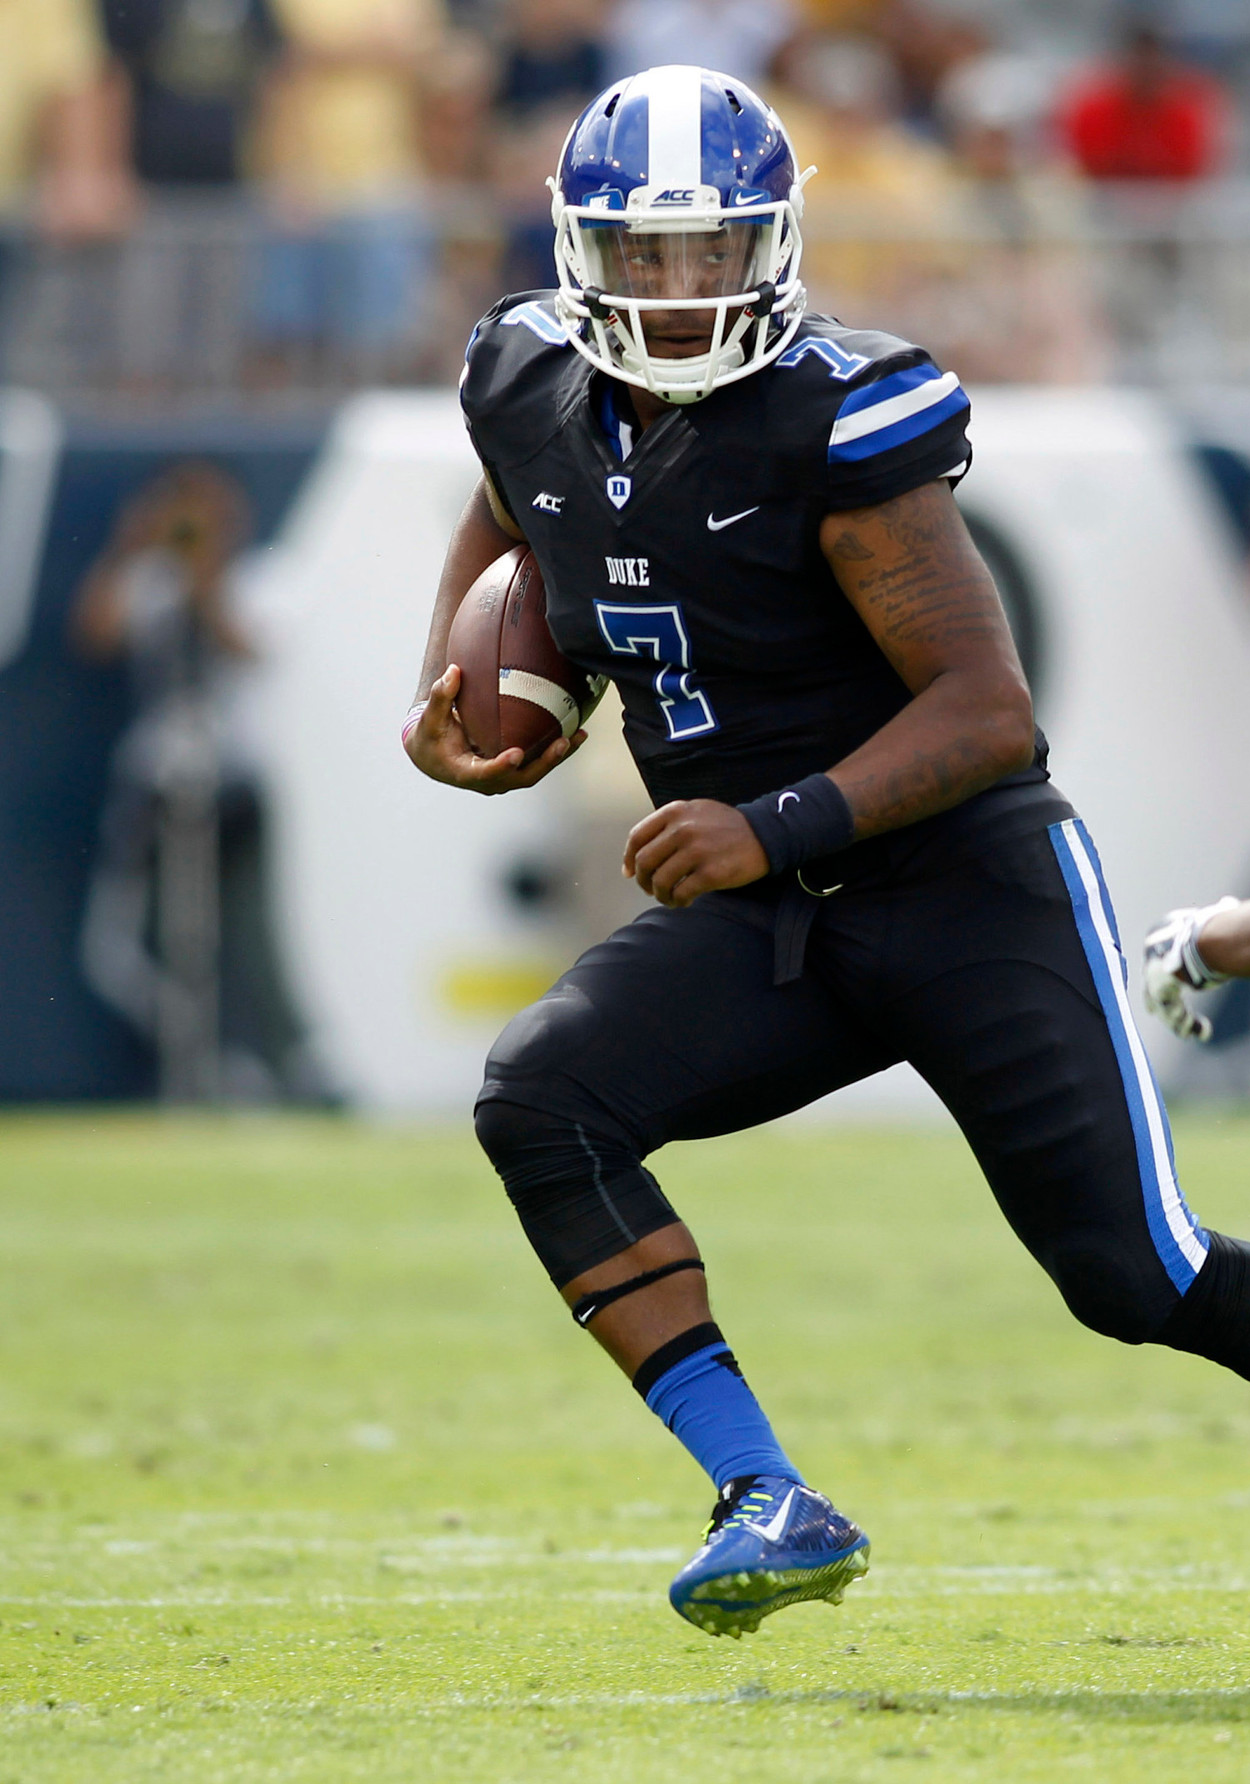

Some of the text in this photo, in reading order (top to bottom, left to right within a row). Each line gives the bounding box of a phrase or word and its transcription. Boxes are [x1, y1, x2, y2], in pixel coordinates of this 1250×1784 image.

[652, 190, 696, 203] ACC
[773, 335, 873, 382] 7
[532, 492, 562, 513] ACC
[605, 556, 650, 586] DUKE
[593, 598, 721, 742] 7
